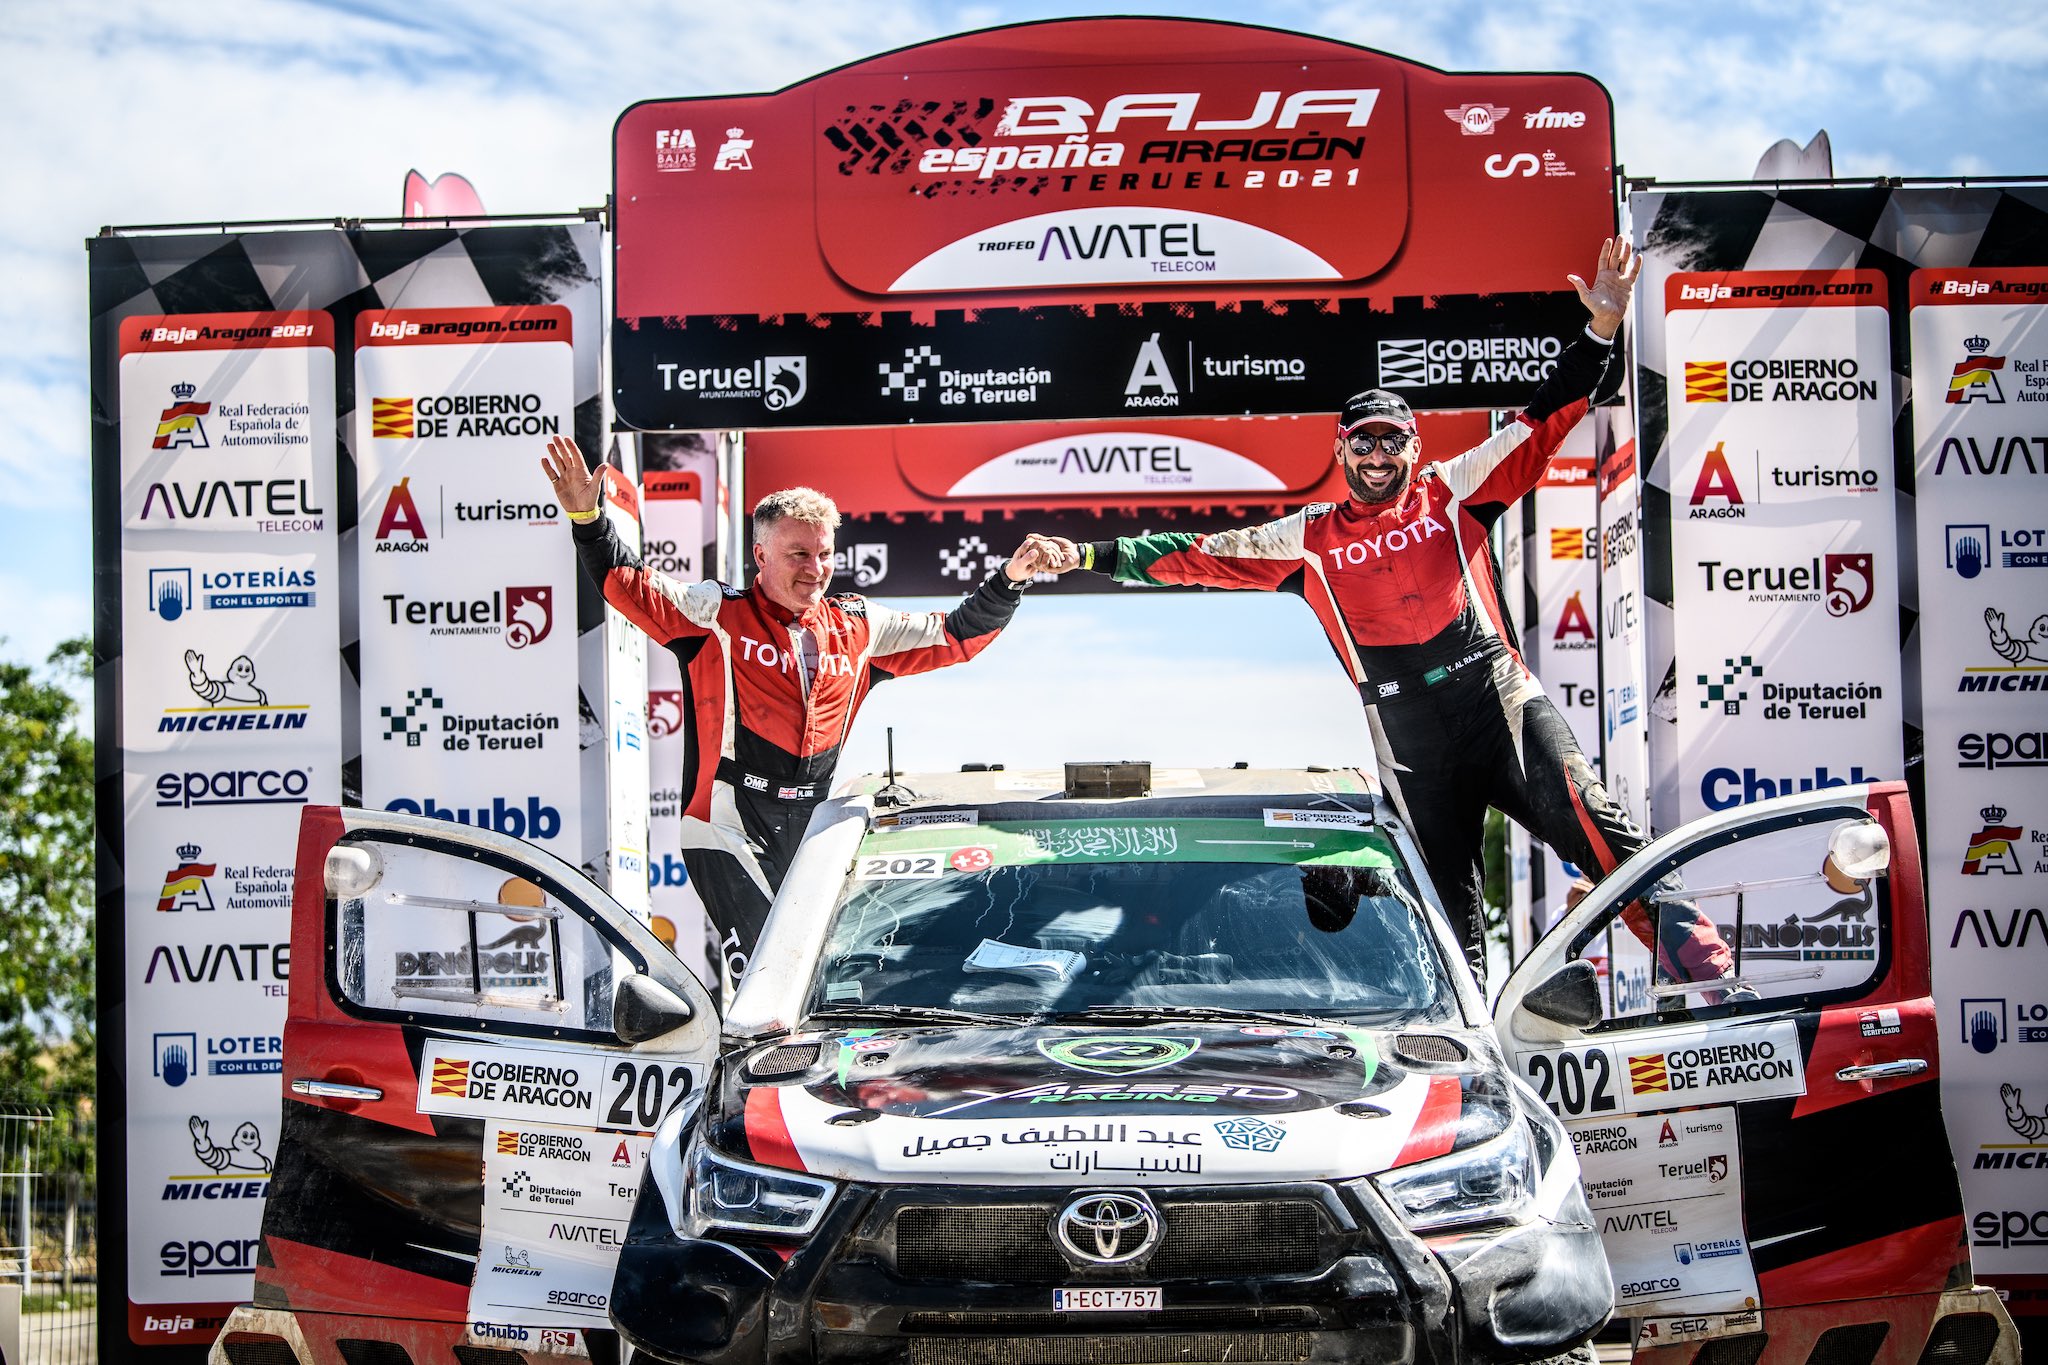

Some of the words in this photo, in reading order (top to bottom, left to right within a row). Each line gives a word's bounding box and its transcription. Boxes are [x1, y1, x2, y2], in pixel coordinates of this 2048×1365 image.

[994, 89, 1380, 137] BAJA
[1467, 113, 1489, 125] FIM
[1523, 106, 1586, 129] rfme
[657, 153, 696, 164] BAJAS
[919, 134, 1125, 179] españa
[1138, 131, 1366, 165] ARAGÓN
[1060, 172, 1232, 192] TERUEL
[1243, 167, 1360, 189] 2021
[978, 240, 1036, 252] TROFEO
[1038, 223, 1216, 261] AVATEL
[1151, 261, 1217, 273] TELECOM
[1680, 282, 1873, 303] bajaaragon.com
[139, 324, 314, 345] #BajaAragon2021
[370, 318, 557, 340] bajaaragon.com
[1428, 336, 1562, 363] GOBIERNO
[657, 359, 761, 391] Teruel
[1203, 354, 1306, 378] turismo
[1428, 361, 1463, 385] DE
[1730, 358, 1859, 380] GOBIERNO
[2014, 359, 2039, 372] Real
[939, 367, 1052, 389] Diputación
[699, 389, 762, 399] AYUNTAMIENTO
[940, 386, 964, 405] de
[972, 384, 1037, 404] Teruel
[1124, 392, 1179, 408] ARAGÓN
[1730, 383, 1763, 401] DE
[1772, 380, 1877, 401] ARAGON
[219, 404, 244, 417] Real
[247, 402, 309, 416] Federación
[416, 393, 541, 416] GOBIERNO
[229, 417, 282, 432] Española
[285, 418, 299, 430] de
[416, 418, 448, 438] DE
[456, 415, 559, 437] ARAGON
[221, 432, 309, 447] Automovilismo
[1059, 446, 1192, 474] AVATEL
[1771, 465, 1878, 487] turismo
[140, 478, 323, 520] AVATEL
[455, 499, 558, 521] turismo
[1689, 505, 1746, 519] ARAGÓN
[256, 519, 324, 533] TELECOM
[375, 539, 429, 553] ARAGÓN
[1328, 515, 1446, 570] TOYOTA
[2015, 556, 2039, 564] CON
[202, 567, 317, 589] LOTERÍAS
[1698, 558, 1821, 591] Teruel
[215, 597, 238, 606] CON
[241, 596, 253, 605] EL
[256, 595, 303, 605] DEPORTE
[1748, 593, 1821, 602] AYUNTAMIENTO
[383, 591, 501, 625] Teruel
[429, 626, 501, 636] AYUNTAMIENTO
[1454, 661, 1464, 670] AL
[1463, 650, 1484, 665] RAJHI
[1378, 683, 1400, 696] OMP
[1762, 682, 1882, 704] Diputación
[1763, 704, 1791, 719] de
[1798, 702, 1866, 719] Teruel
[157, 713, 308, 733] MICHELIN
[442, 713, 559, 734] Diputación
[443, 735, 470, 751] de
[476, 732, 543, 750] Teruel
[156, 769, 309, 809] sparco
[743, 776, 769, 790] OMP
[919, 817, 971, 825] ARAGON
[1294, 812, 1356, 820] GOBIERNO
[864, 858, 937, 876] 202
[954, 849, 990, 868] +3
[224, 867, 249, 880] Real
[234, 880, 288, 895] Española
[1810, 951, 1869, 960] TERUEL
[1861, 1022, 1875, 1031] CAR
[1863, 1026, 1901, 1037] VERIFICADO
[220, 1063, 244, 1072] CON
[248, 1062, 260, 1071] EL
[471, 1061, 579, 1088] GOBIERNO
[1670, 1070, 1699, 1092] DE
[1705, 1059, 1794, 1088] ARAGON
[1528, 1048, 1617, 1116] 202
[1667, 1040, 1775, 1070] GOBIERNO
[468, 1080, 497, 1101] DE
[502, 1084, 593, 1110] ARAGON
[1029, 1092, 1228, 1104] RACING
[1001, 1124, 1127, 1148] اللطيف
[1137, 1126, 1202, 1147] عبد
[1686, 1122, 1723, 1134] turismo
[520, 1132, 583, 1149] GOBIERNO
[902, 1133, 992, 1159] جميل
[1585, 1137, 1638, 1155] ARAGON
[519, 1145, 535, 1158] DE
[538, 1146, 591, 1163] ARAGON
[1658, 1158, 1707, 1178] Teruel
[529, 1184, 582, 1198] Diputación
[529, 1193, 541, 1203] de
[543, 1195, 575, 1206] Teruel
[1596, 1187, 1627, 1199] Teruel
[1603, 1210, 1678, 1234] AVATEL
[1650, 1226, 1678, 1235] TELECOM
[1695, 1239, 1741, 1252] LOTERÍAS
[491, 1266, 544, 1278] MICHELIN
[1621, 1276, 1681, 1299] sparco
[547, 1289, 607, 1310] sparco
[1064, 1291, 1158, 1308] 1-ECT-757
[473, 1321, 529, 1342] Chubb
[542, 1330, 571, 1345] as
